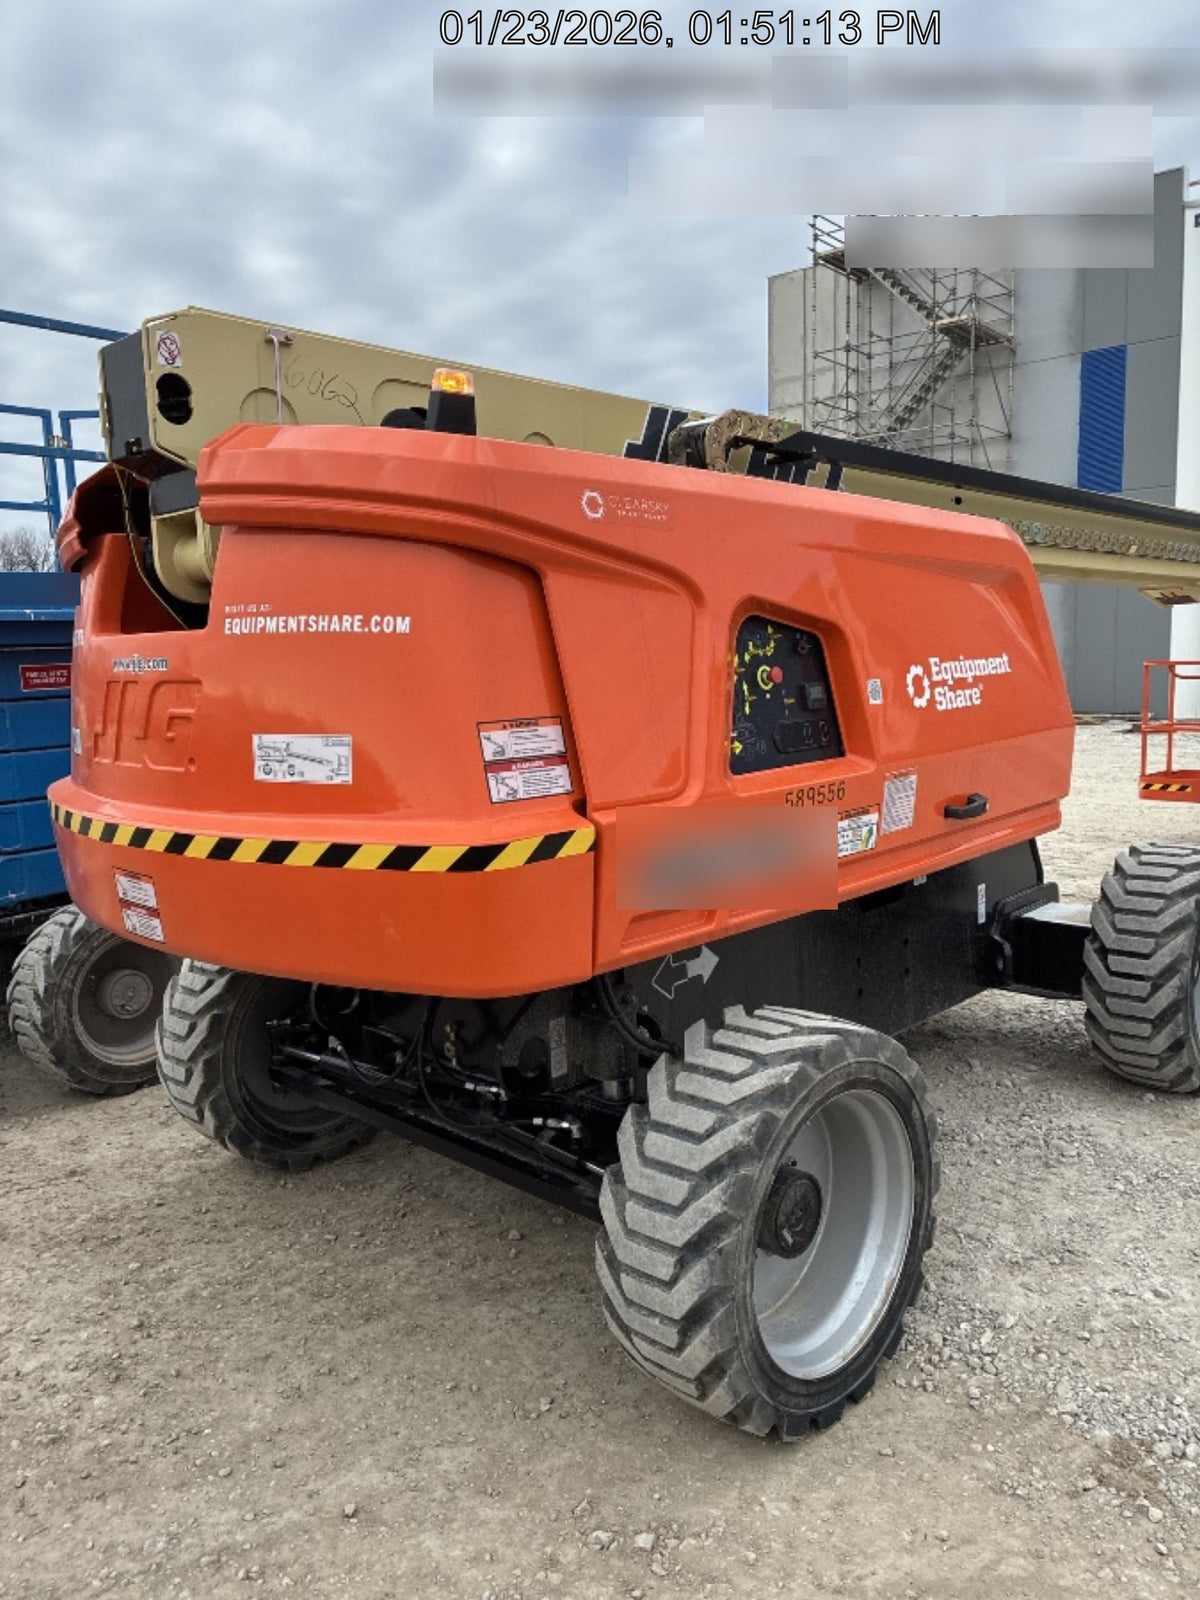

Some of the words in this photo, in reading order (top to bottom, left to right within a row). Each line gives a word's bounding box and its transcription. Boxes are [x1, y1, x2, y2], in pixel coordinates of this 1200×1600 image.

[224, 614, 411, 635] EQUIPMENTSHARE.COM
[928, 652, 1012, 685] Equipment
[934, 685, 982, 712] Share
[93, 679, 203, 773] JLG
[785, 780, 847, 807] 589556
